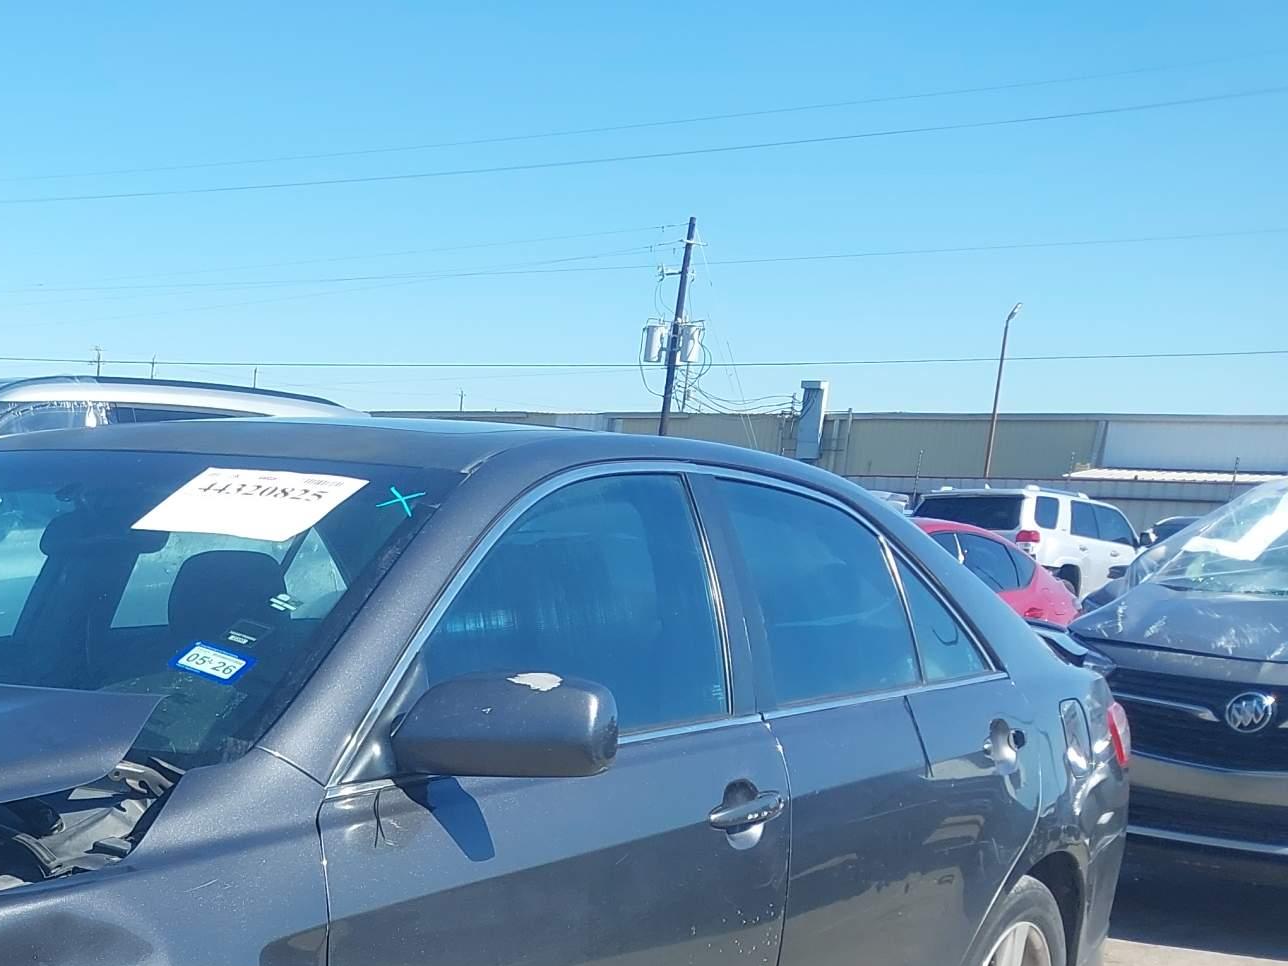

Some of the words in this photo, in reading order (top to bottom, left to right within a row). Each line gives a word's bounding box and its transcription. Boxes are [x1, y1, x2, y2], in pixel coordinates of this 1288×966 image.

[198, 482, 329, 502] 44320825
[186, 652, 210, 667] 05
[212, 660, 237, 676] 26
